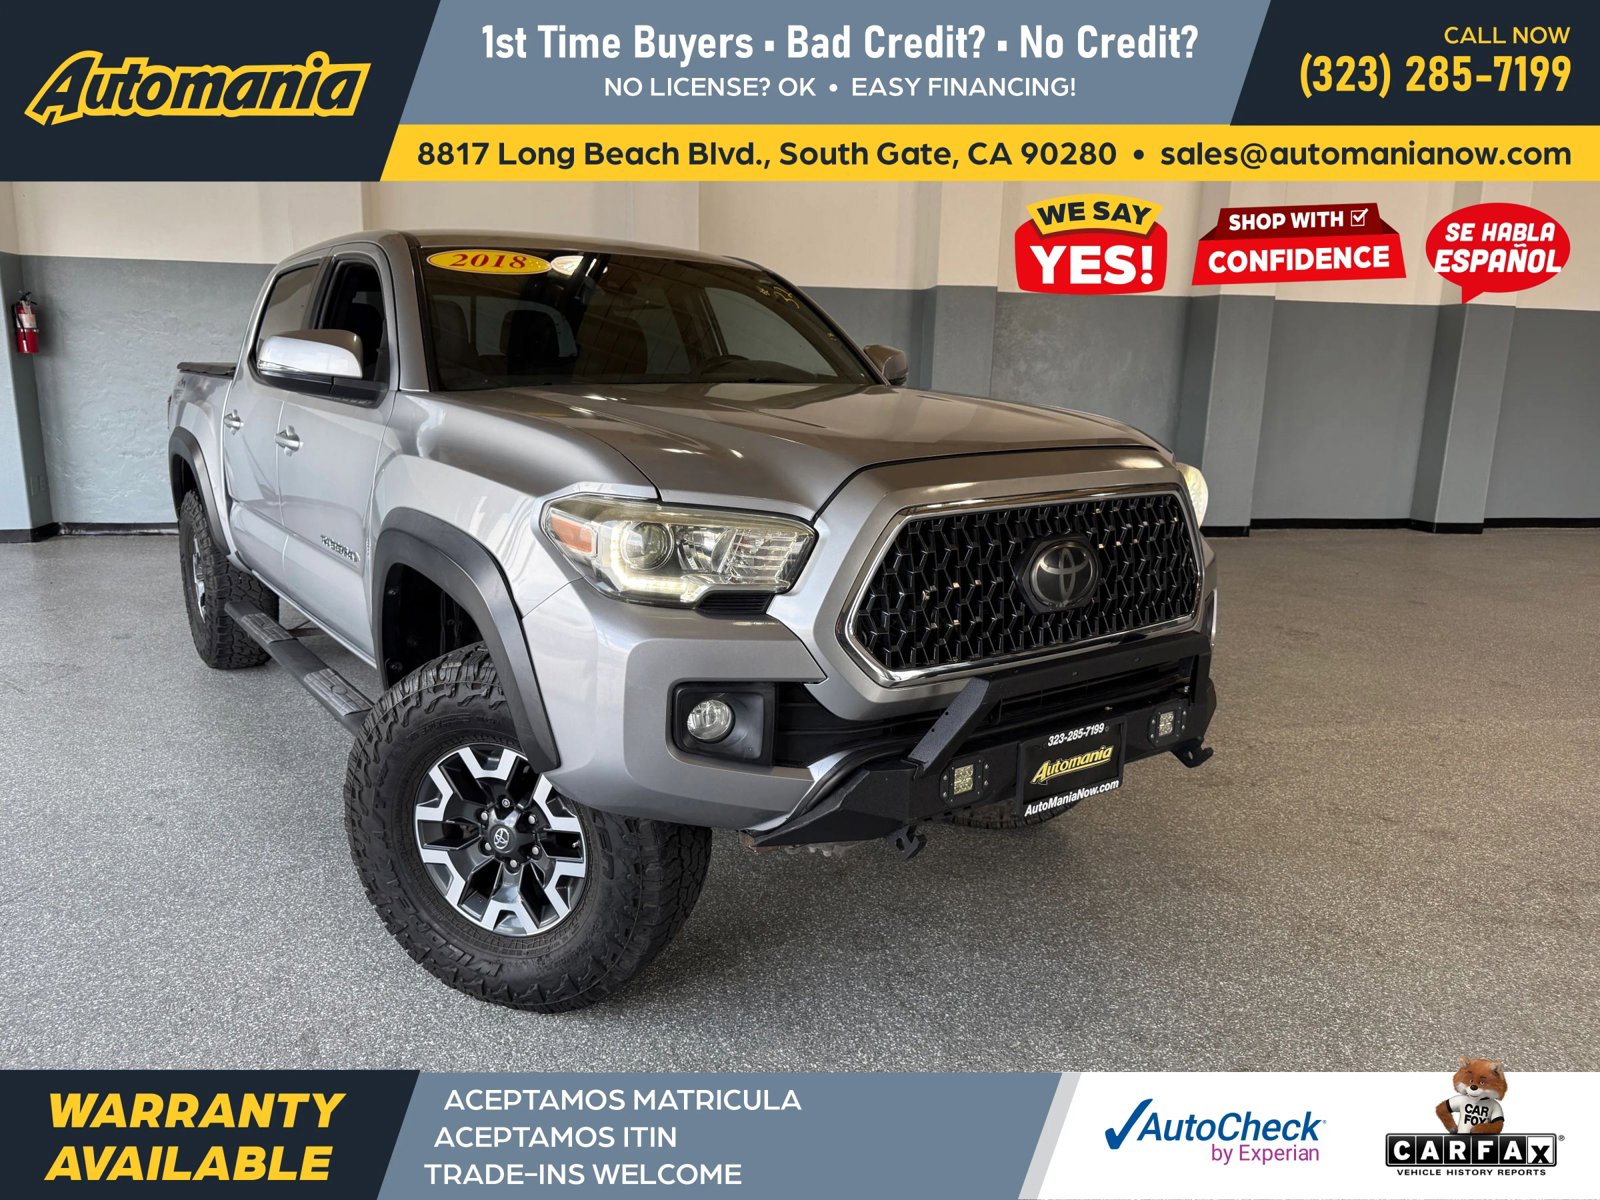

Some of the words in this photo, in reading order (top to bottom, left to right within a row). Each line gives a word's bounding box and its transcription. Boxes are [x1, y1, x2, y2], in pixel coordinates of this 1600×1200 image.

[450, 254, 527, 269] 2018
[1047, 722, 1105, 746] 323-285-7199
[1031, 746, 1113, 784] Automania
[1024, 780, 1119, 817] AutoManiaNow.com
